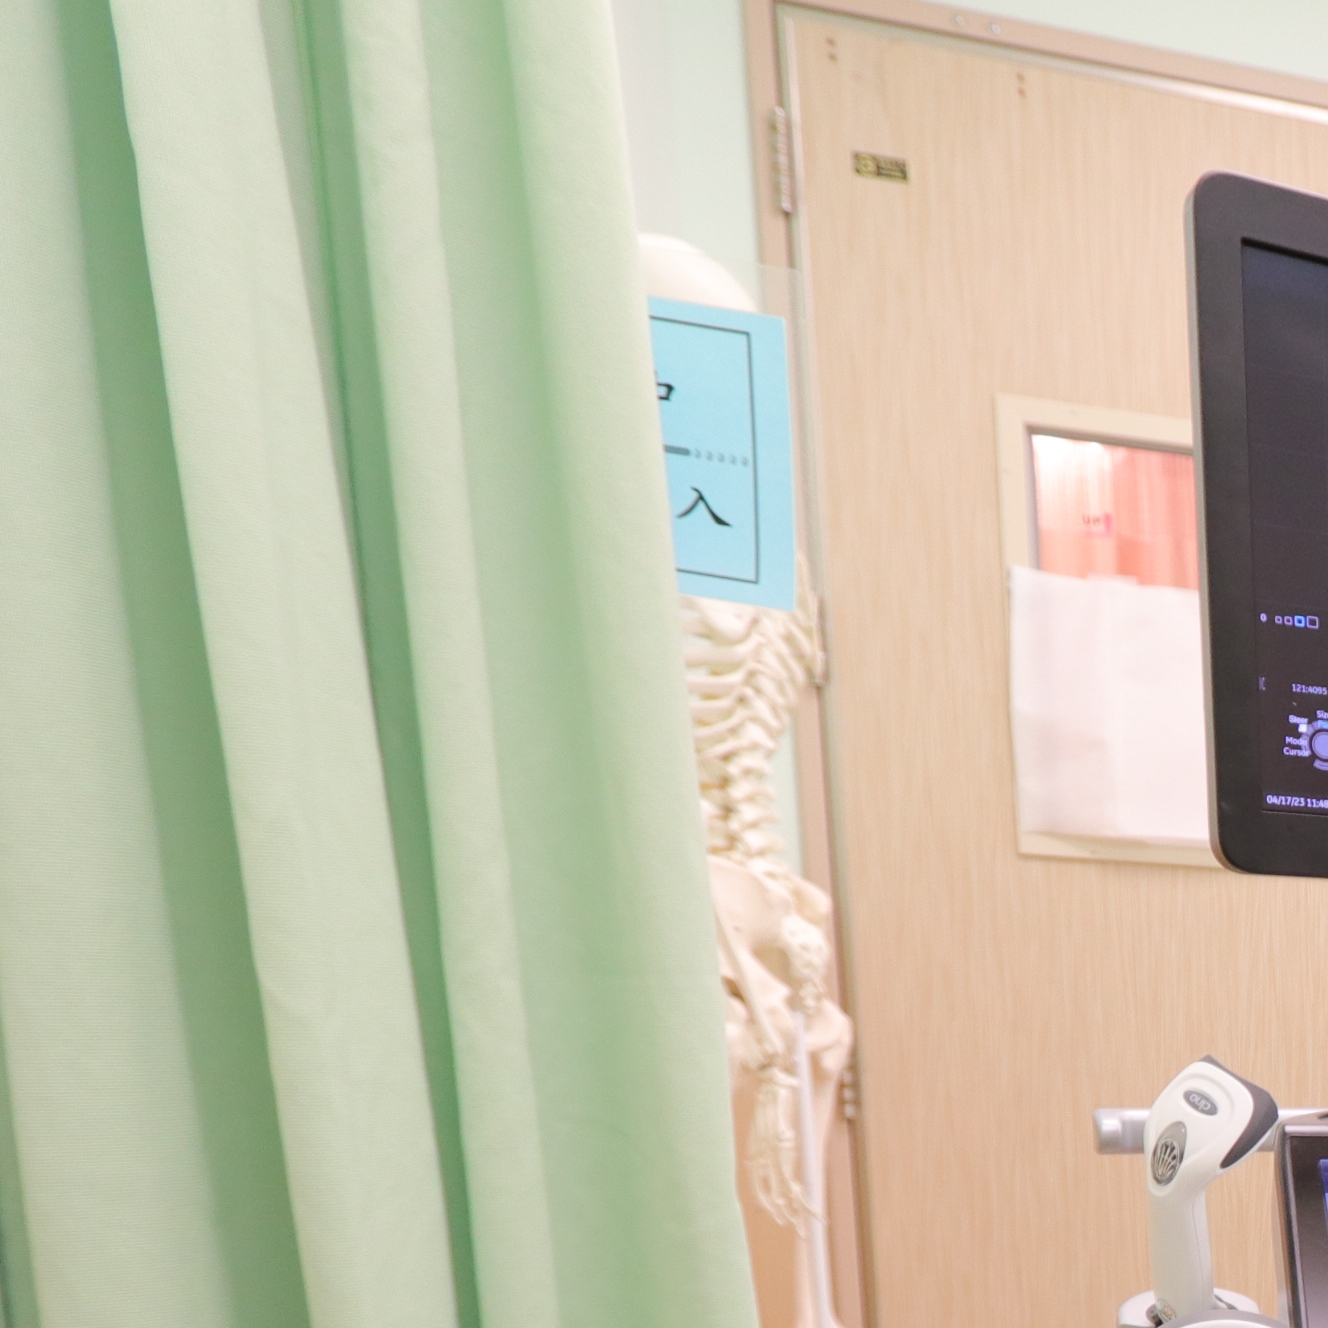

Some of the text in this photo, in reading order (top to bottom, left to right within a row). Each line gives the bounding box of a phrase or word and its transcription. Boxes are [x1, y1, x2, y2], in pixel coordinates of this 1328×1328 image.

[676, 486, 733, 527] 入
[1291, 683, 1328, 695] 121:4095
[1288, 715, 1309, 724] Steer
[1285, 737, 1307, 745] Mode
[1283, 747, 1310, 757] Cursor
[1266, 794, 1305, 808] 04/17/23
